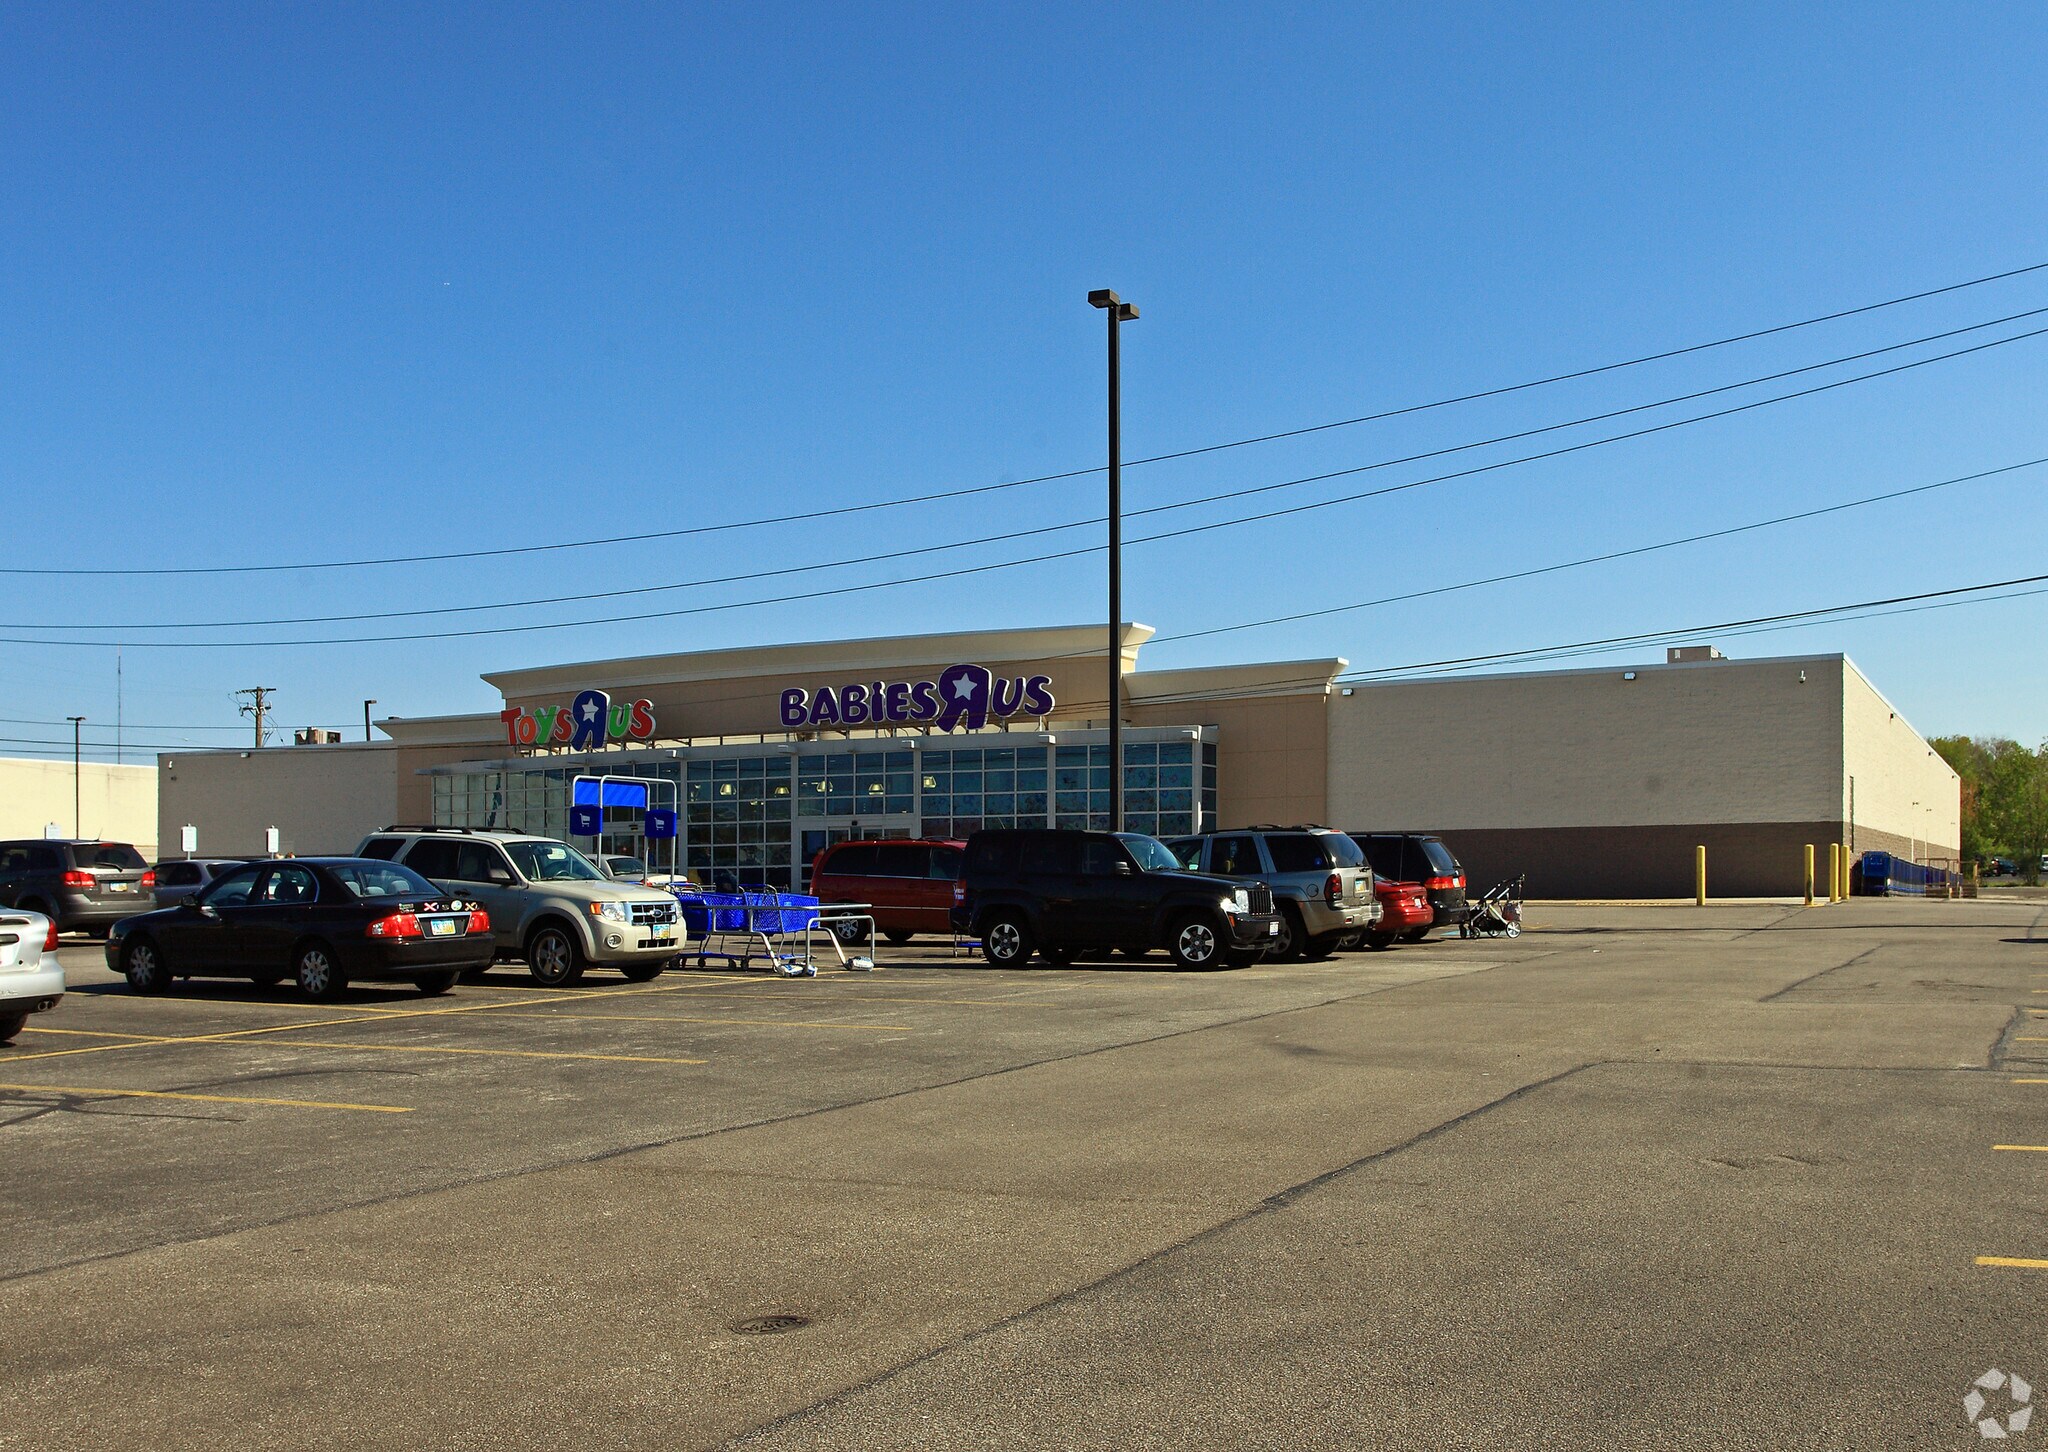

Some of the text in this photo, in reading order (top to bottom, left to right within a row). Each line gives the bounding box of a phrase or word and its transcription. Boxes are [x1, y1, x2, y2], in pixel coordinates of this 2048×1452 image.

[992, 675, 1055, 718] US
[501, 705, 574, 746] TOYS
[608, 699, 655, 739] US
